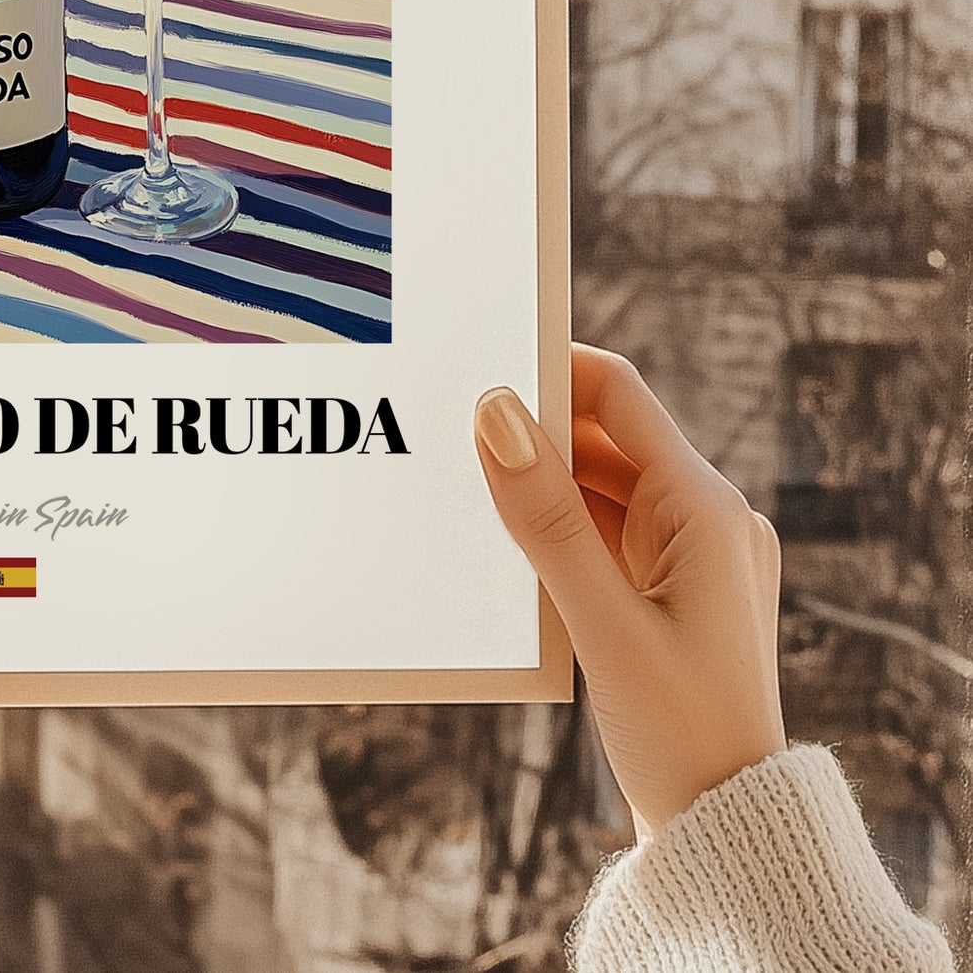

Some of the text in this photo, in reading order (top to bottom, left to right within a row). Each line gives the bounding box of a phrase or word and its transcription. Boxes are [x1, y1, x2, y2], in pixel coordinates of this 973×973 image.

[33, 397, 137, 455] DE
[151, 397, 412, 455] RUEDA
[33, 495, 130, 542] Spain
